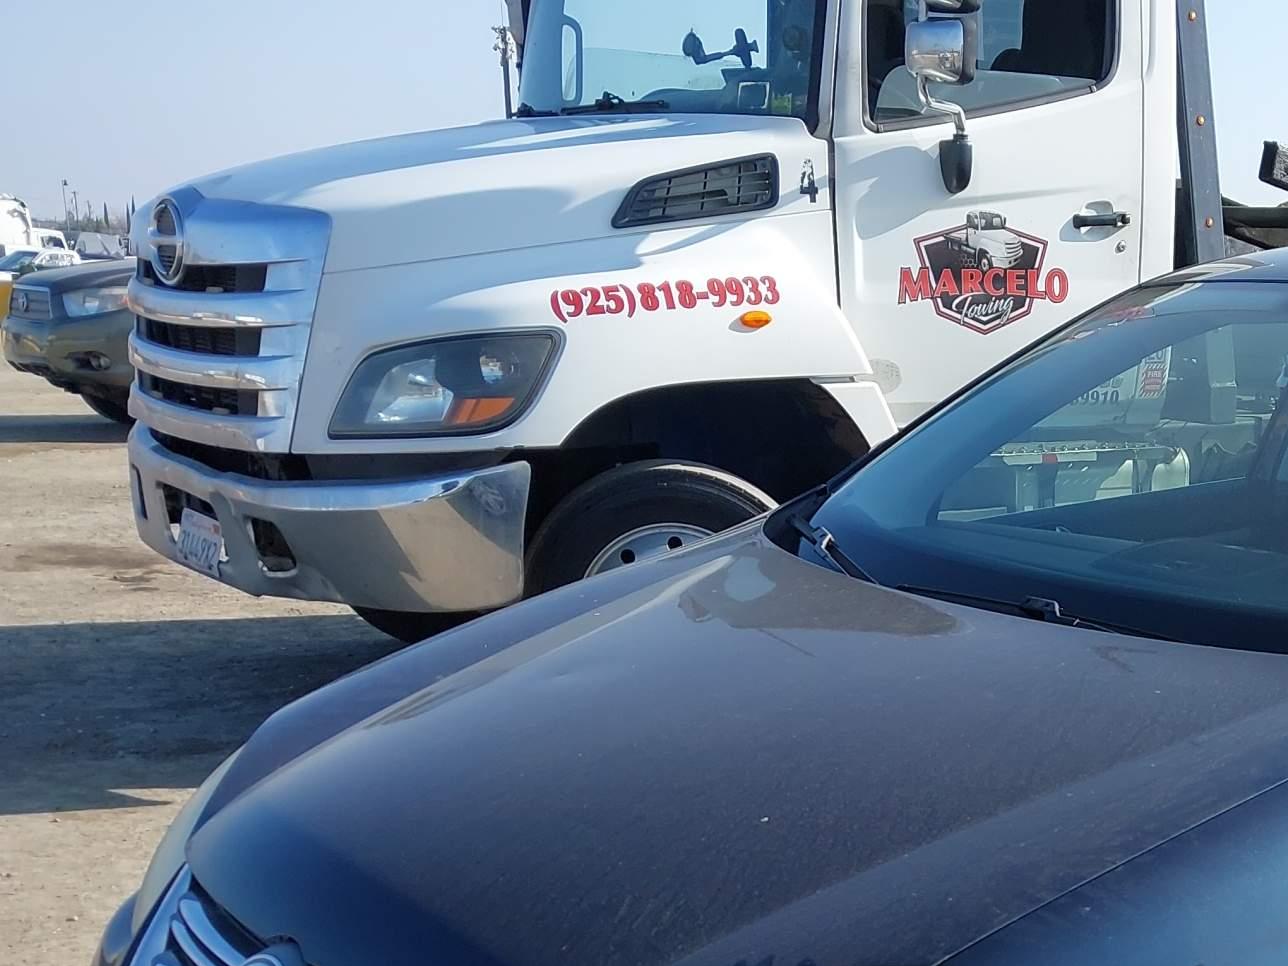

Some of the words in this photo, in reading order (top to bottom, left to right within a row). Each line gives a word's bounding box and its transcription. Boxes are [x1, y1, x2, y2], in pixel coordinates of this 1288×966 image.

[551, 276, 780, 323] (925)818-9933
[898, 267, 1069, 304] MARCELO
[952, 292, 1014, 325] Towing
